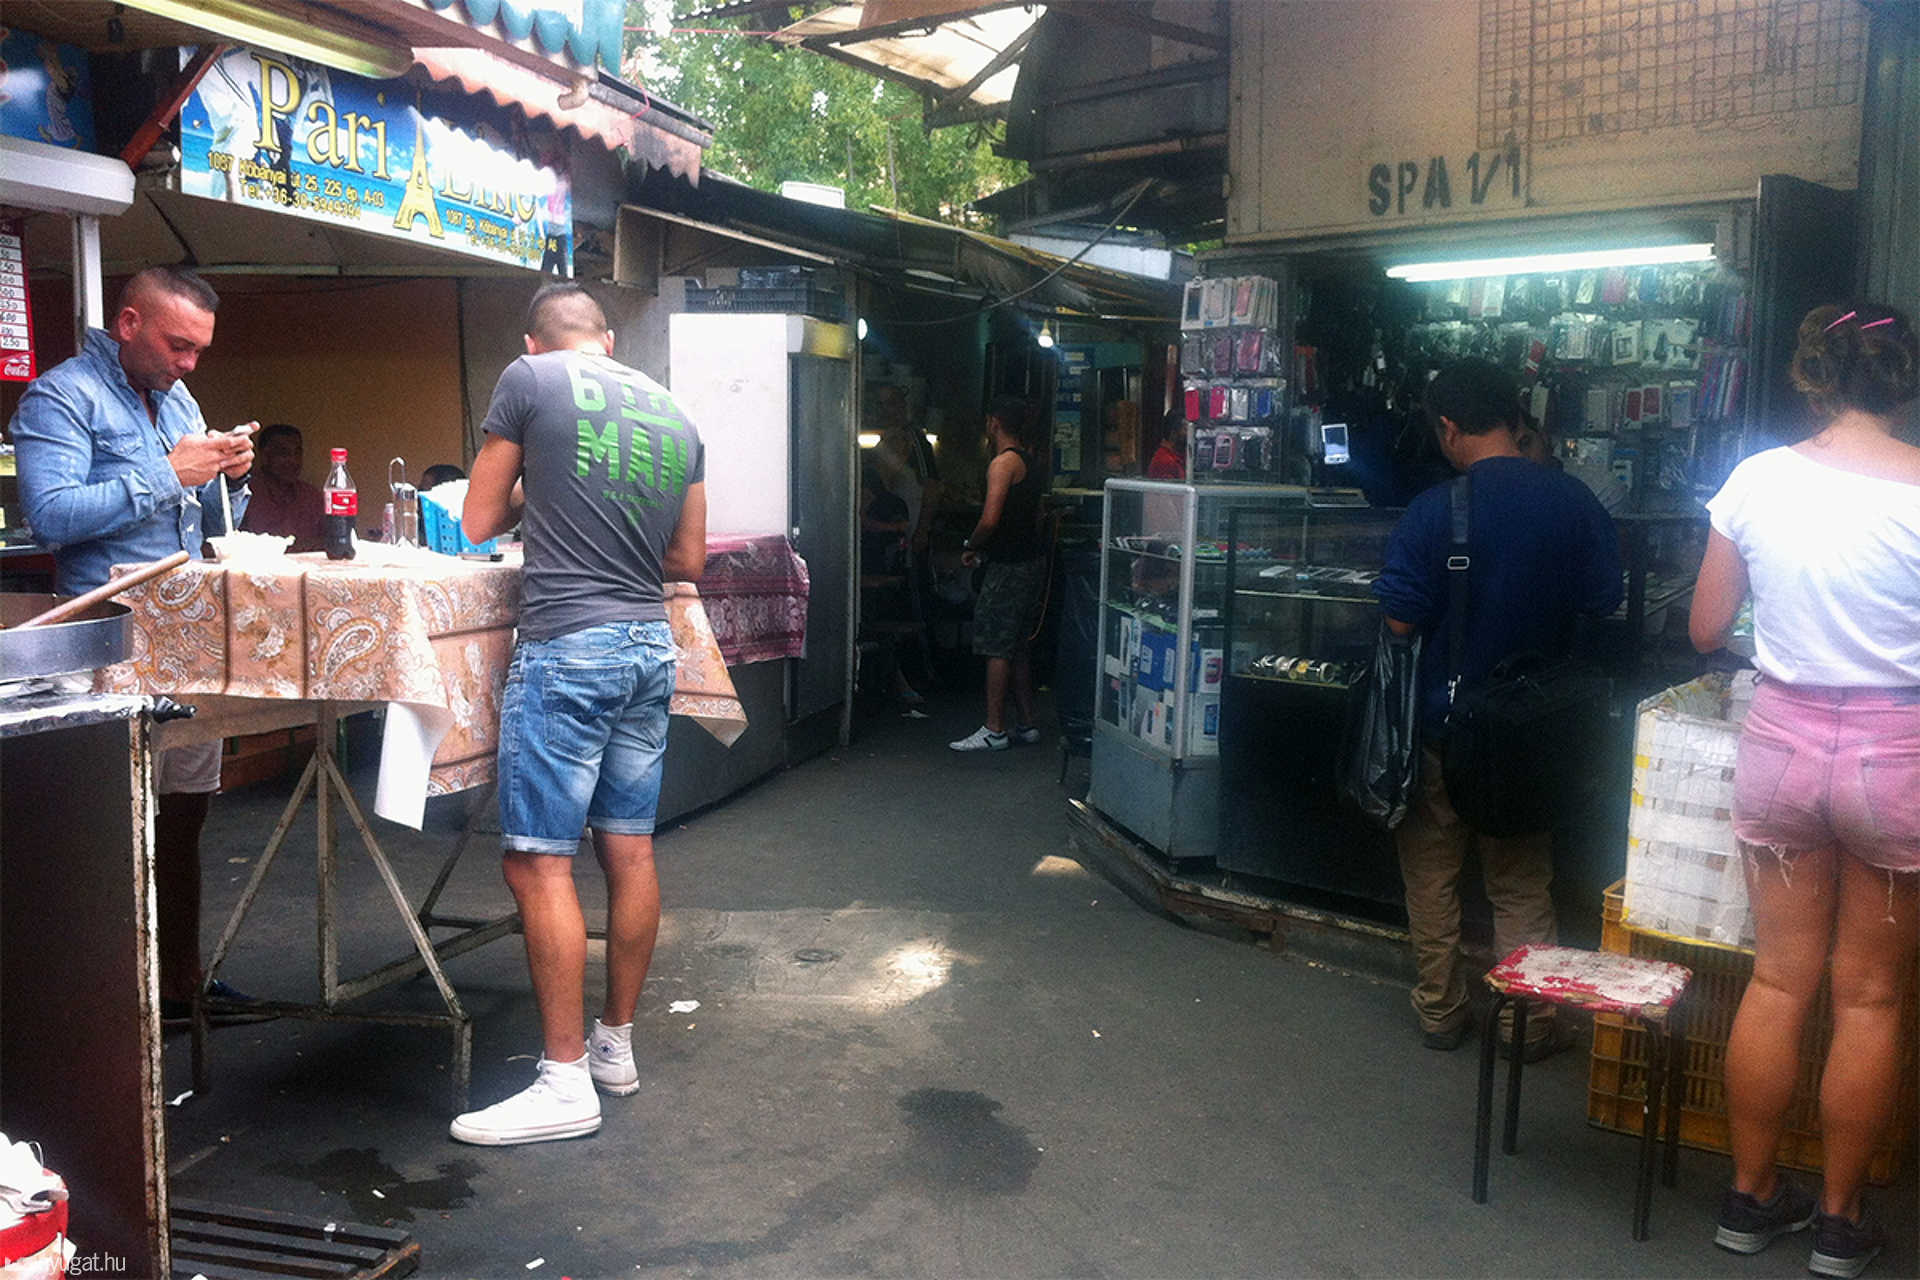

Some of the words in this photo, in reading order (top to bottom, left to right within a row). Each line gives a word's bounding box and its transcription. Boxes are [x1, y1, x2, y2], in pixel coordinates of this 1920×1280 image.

[252, 53, 391, 181] Pari
[1368, 155, 1451, 216] SPA
[577, 419, 689, 494] MAN
